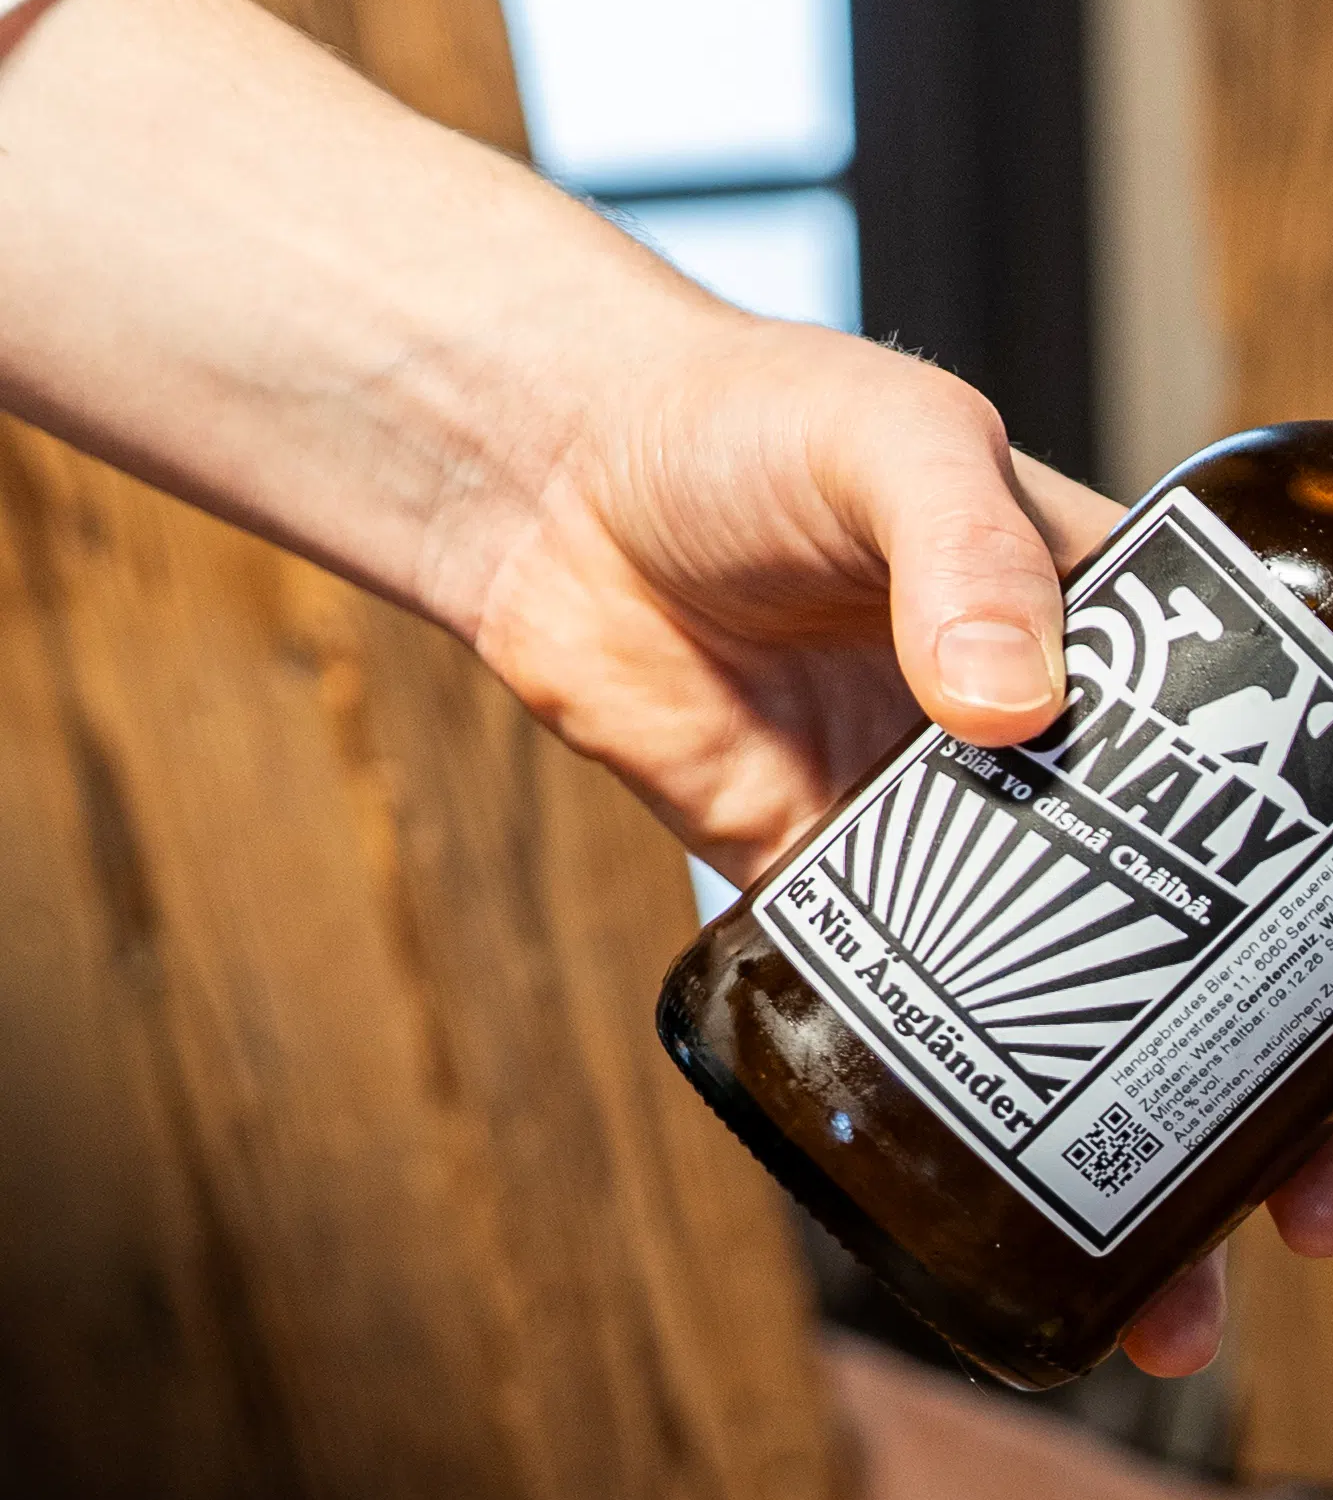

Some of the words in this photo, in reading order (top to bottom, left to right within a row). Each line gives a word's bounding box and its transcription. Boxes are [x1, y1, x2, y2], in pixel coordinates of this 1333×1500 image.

[1000, 773, 1034, 800] vo
[1032, 794, 1112, 854] disnä
[1109, 844, 1212, 927] Chäibä.
[788, 877, 818, 910] dr
[808, 898, 862, 963] Niu
[855, 946, 1036, 1134] Ängländer
[1110, 993, 1208, 1086] Handgebrautes
[1204, 965, 1234, 994] Bier
[1232, 941, 1260, 966] von
[1258, 918, 1282, 943] der
[1124, 993, 1234, 1099] Bitzighoferstrasse
[1254, 938, 1288, 972] 6060
[1285, 894, 1333, 940] Sarnen
[1138, 1061, 1193, 1113] Zutaten:
[1236, 933, 1325, 1014] Gerstenmalz,
[1149, 1054, 1223, 1123] Mindestens
[1220, 1007, 1270, 1055] haltbar:
[1267, 952, 1324, 1008] 09.12.26
[1173, 1117, 1201, 1144] Aus
[1252, 997, 1322, 1066] natürlichen
[1162, 1109, 1186, 1132] 6.3
[1183, 1097, 1200, 1110] %
[1199, 1074, 1224, 1096] vol.
